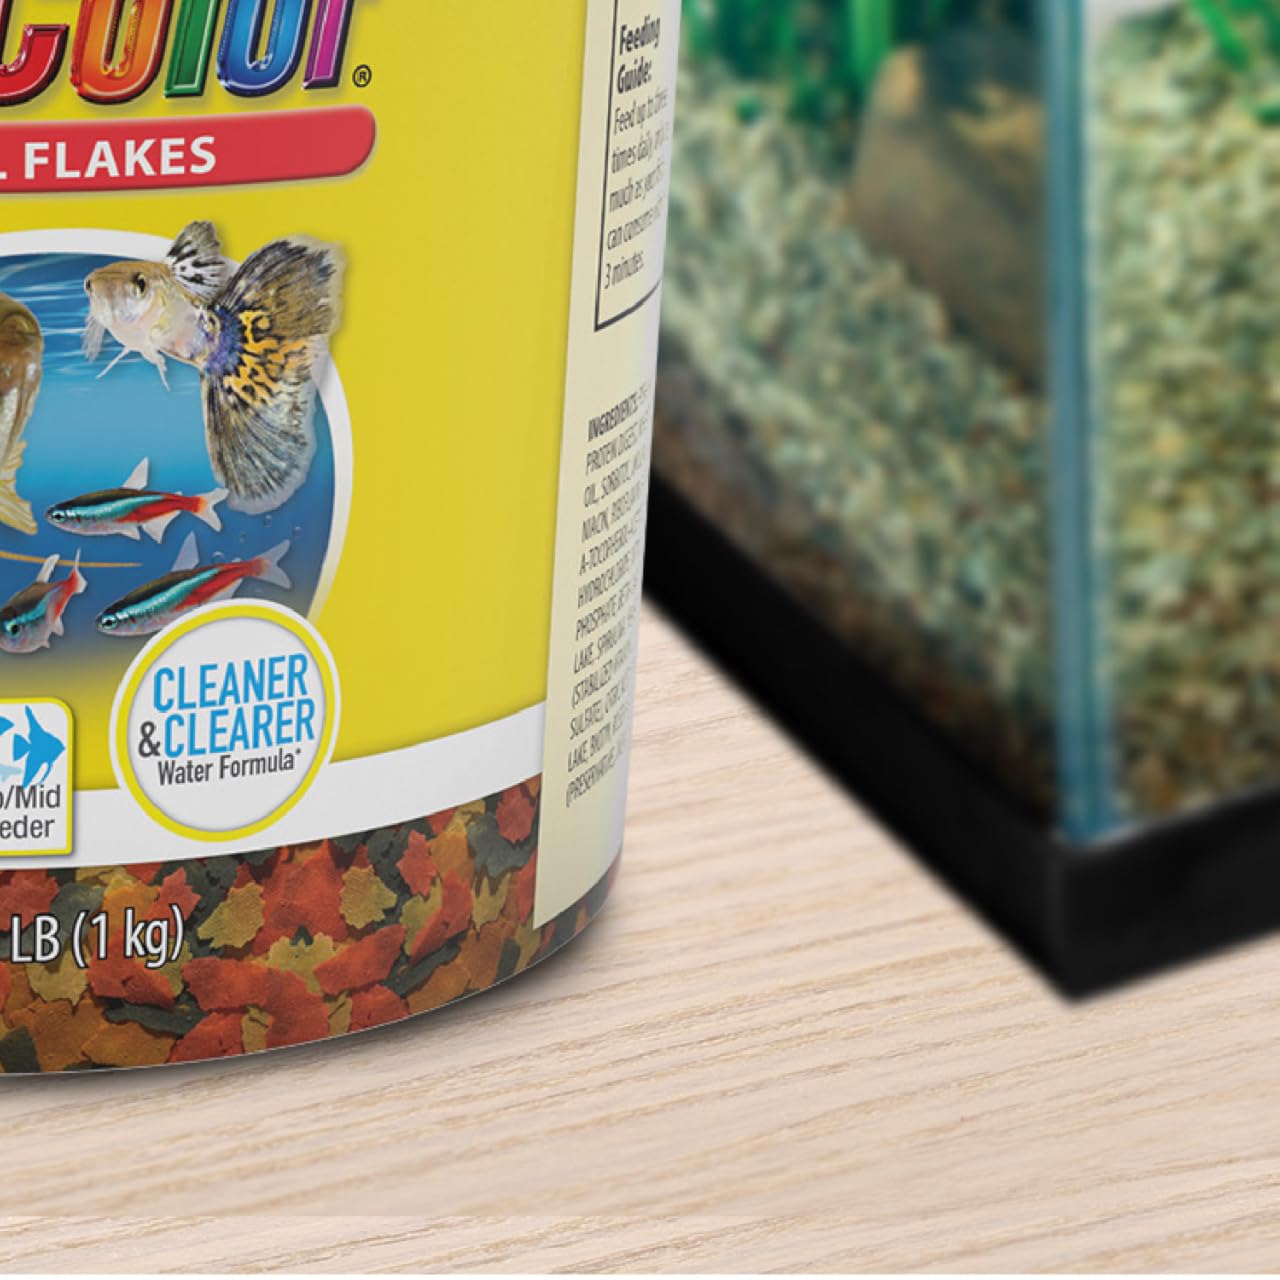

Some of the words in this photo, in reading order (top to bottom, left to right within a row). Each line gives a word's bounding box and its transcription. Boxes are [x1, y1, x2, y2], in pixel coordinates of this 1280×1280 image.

[619, 14, 660, 56] Feeding
[22, 135, 217, 180] FLAKES
[153, 653, 308, 713] CLEANER
[158, 759, 213, 786] Water
[10, 914, 61, 965] LB
[71, 909, 110, 969] (1
[124, 904, 184, 969] kg)
